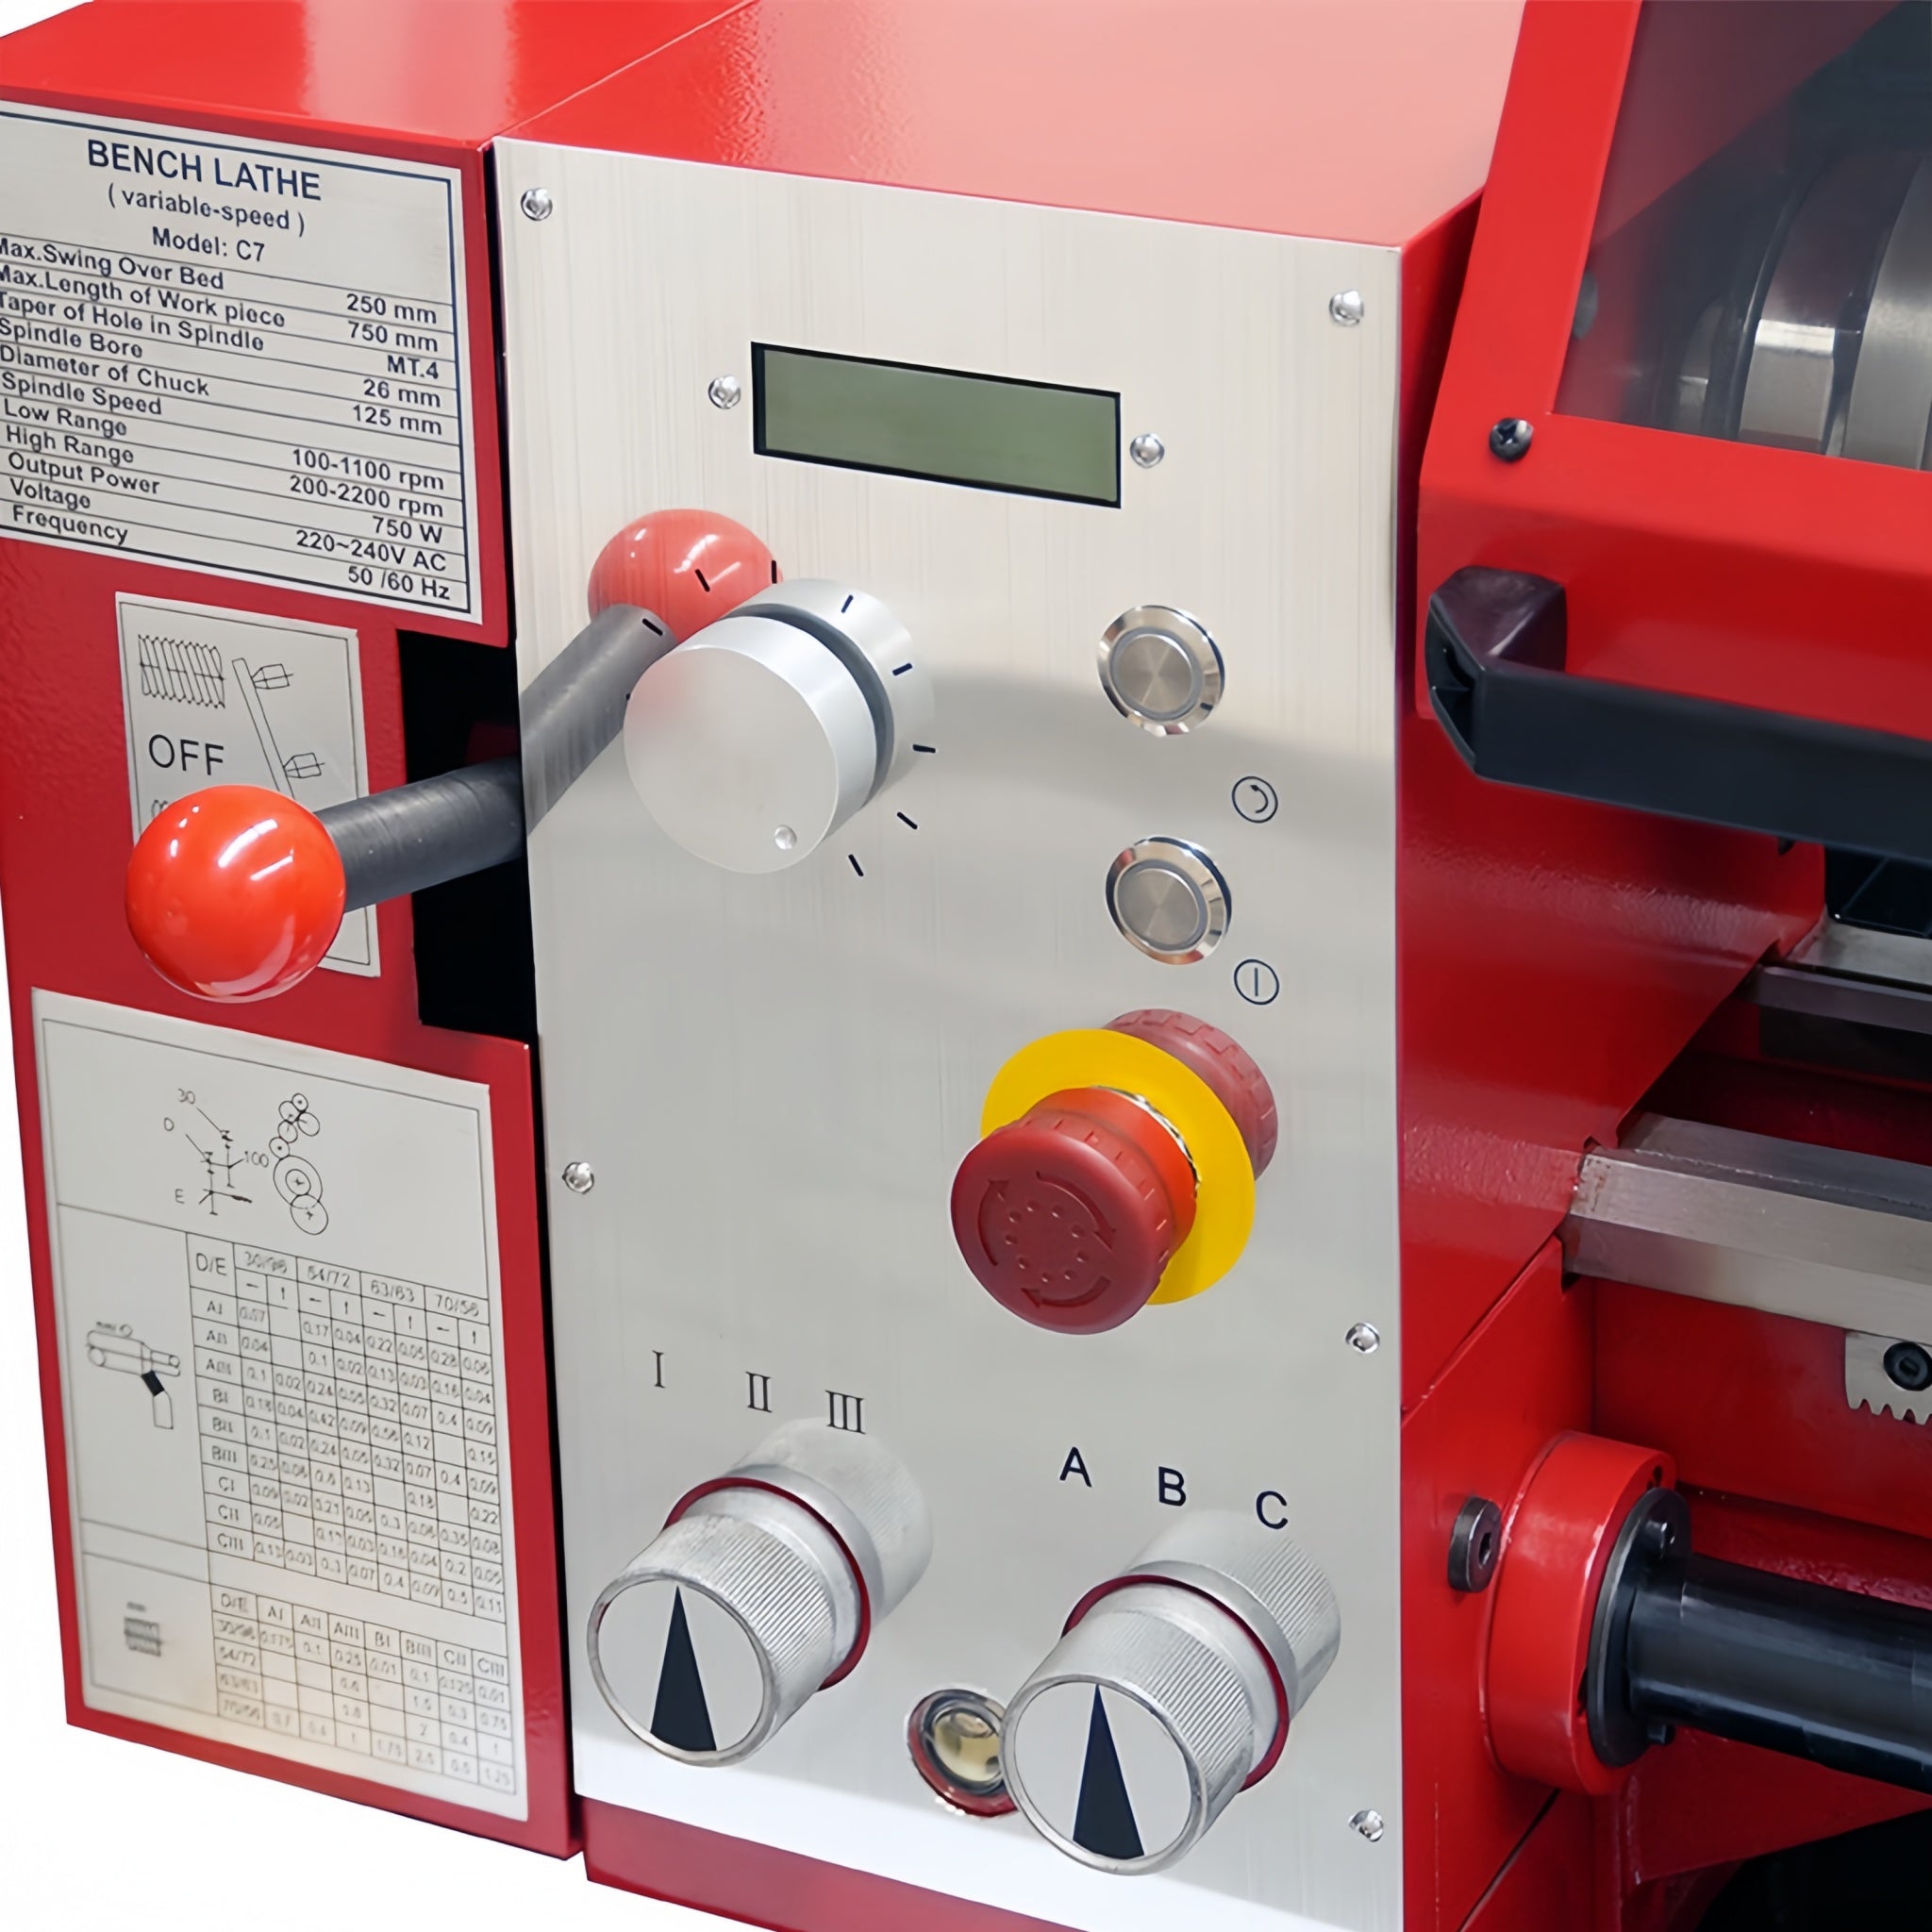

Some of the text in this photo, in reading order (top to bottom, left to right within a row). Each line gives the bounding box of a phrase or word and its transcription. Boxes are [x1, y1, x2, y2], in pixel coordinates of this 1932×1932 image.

[88, 139, 322, 201] BENCH LATHE
[152, 226, 265, 262] Model: C7
[119, 257, 173, 281] Over
[180, 266, 224, 290] Bed
[346, 293, 386, 315] 250
[394, 305, 437, 324] mm
[130, 287, 151, 305] of
[158, 290, 218, 316] Work
[348, 320, 388, 343] 750
[396, 333, 438, 352] mm
[0, 317, 441, 408] Spindle Bore 26 mm
[63, 303, 85, 322] of
[92, 306, 142, 330] Hole
[151, 315, 171, 335] in
[178, 321, 264, 351] Spindle
[388, 355, 439, 379] MT.4
[0, 344, 441, 435] Diameter of Chuck 125 mm
[2, 371, 162, 415] Spindle Speed
[4, 398, 443, 491] Low Range 100-1100 rpm
[6, 425, 443, 517] High Range 200-2200 rpm
[8, 452, 442, 543] Output Power 750 W
[10, 477, 91, 510] Voltage
[413, 551, 446, 572] AC
[12, 504, 128, 545] Frequency
[348, 566, 373, 586] 50
[422, 577, 451, 600] Hz
[148, 734, 225, 775] OFF
[178, 1088, 196, 1106] 30
[242, 1150, 270, 1169] 100
[175, 1189, 185, 1205] E
[195, 1252, 227, 1276] D/E
[652, 1350, 867, 1435] I II III
[1058, 1446, 1289, 1530] A B C
